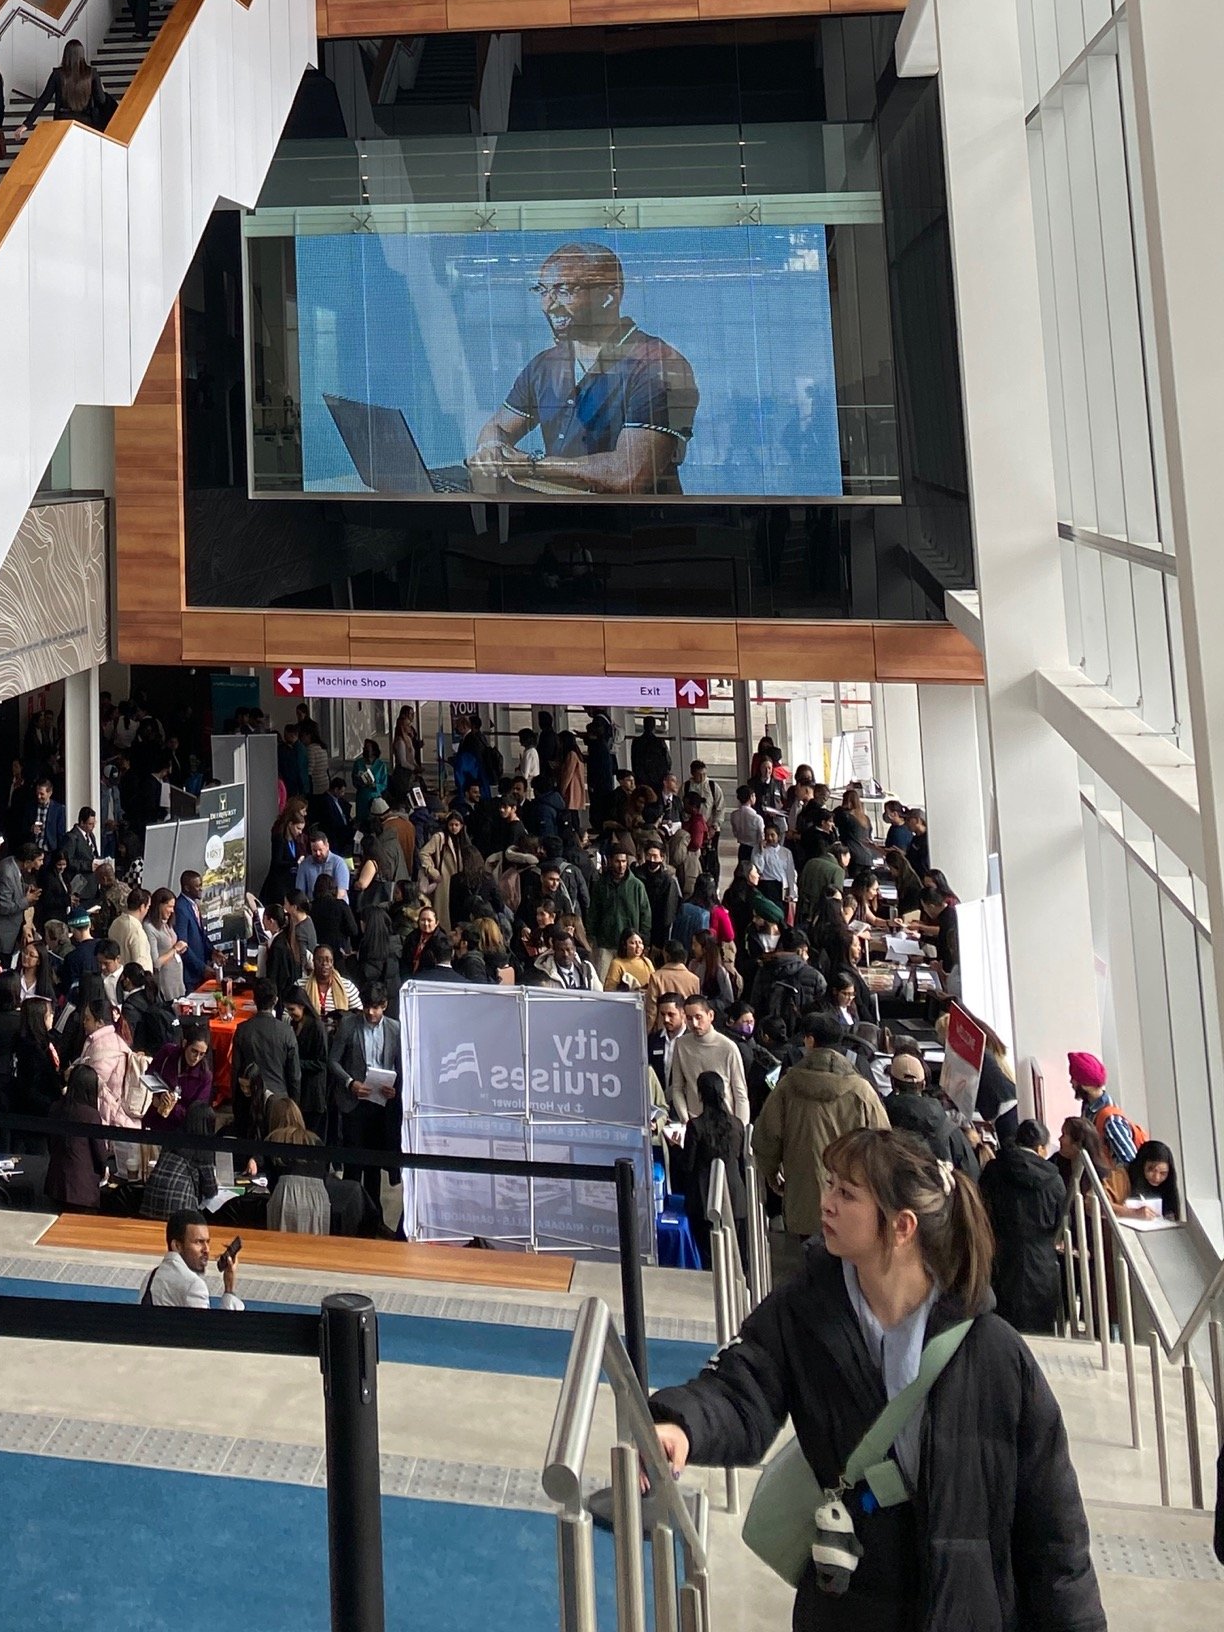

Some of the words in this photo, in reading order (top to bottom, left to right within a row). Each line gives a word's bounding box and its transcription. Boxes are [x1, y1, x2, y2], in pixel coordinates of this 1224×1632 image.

[317, 676, 358, 687] Machine
[360, 677, 387, 688] Shop
[640, 686, 661, 696] Exit
[452, 702, 477, 716] YOU!
